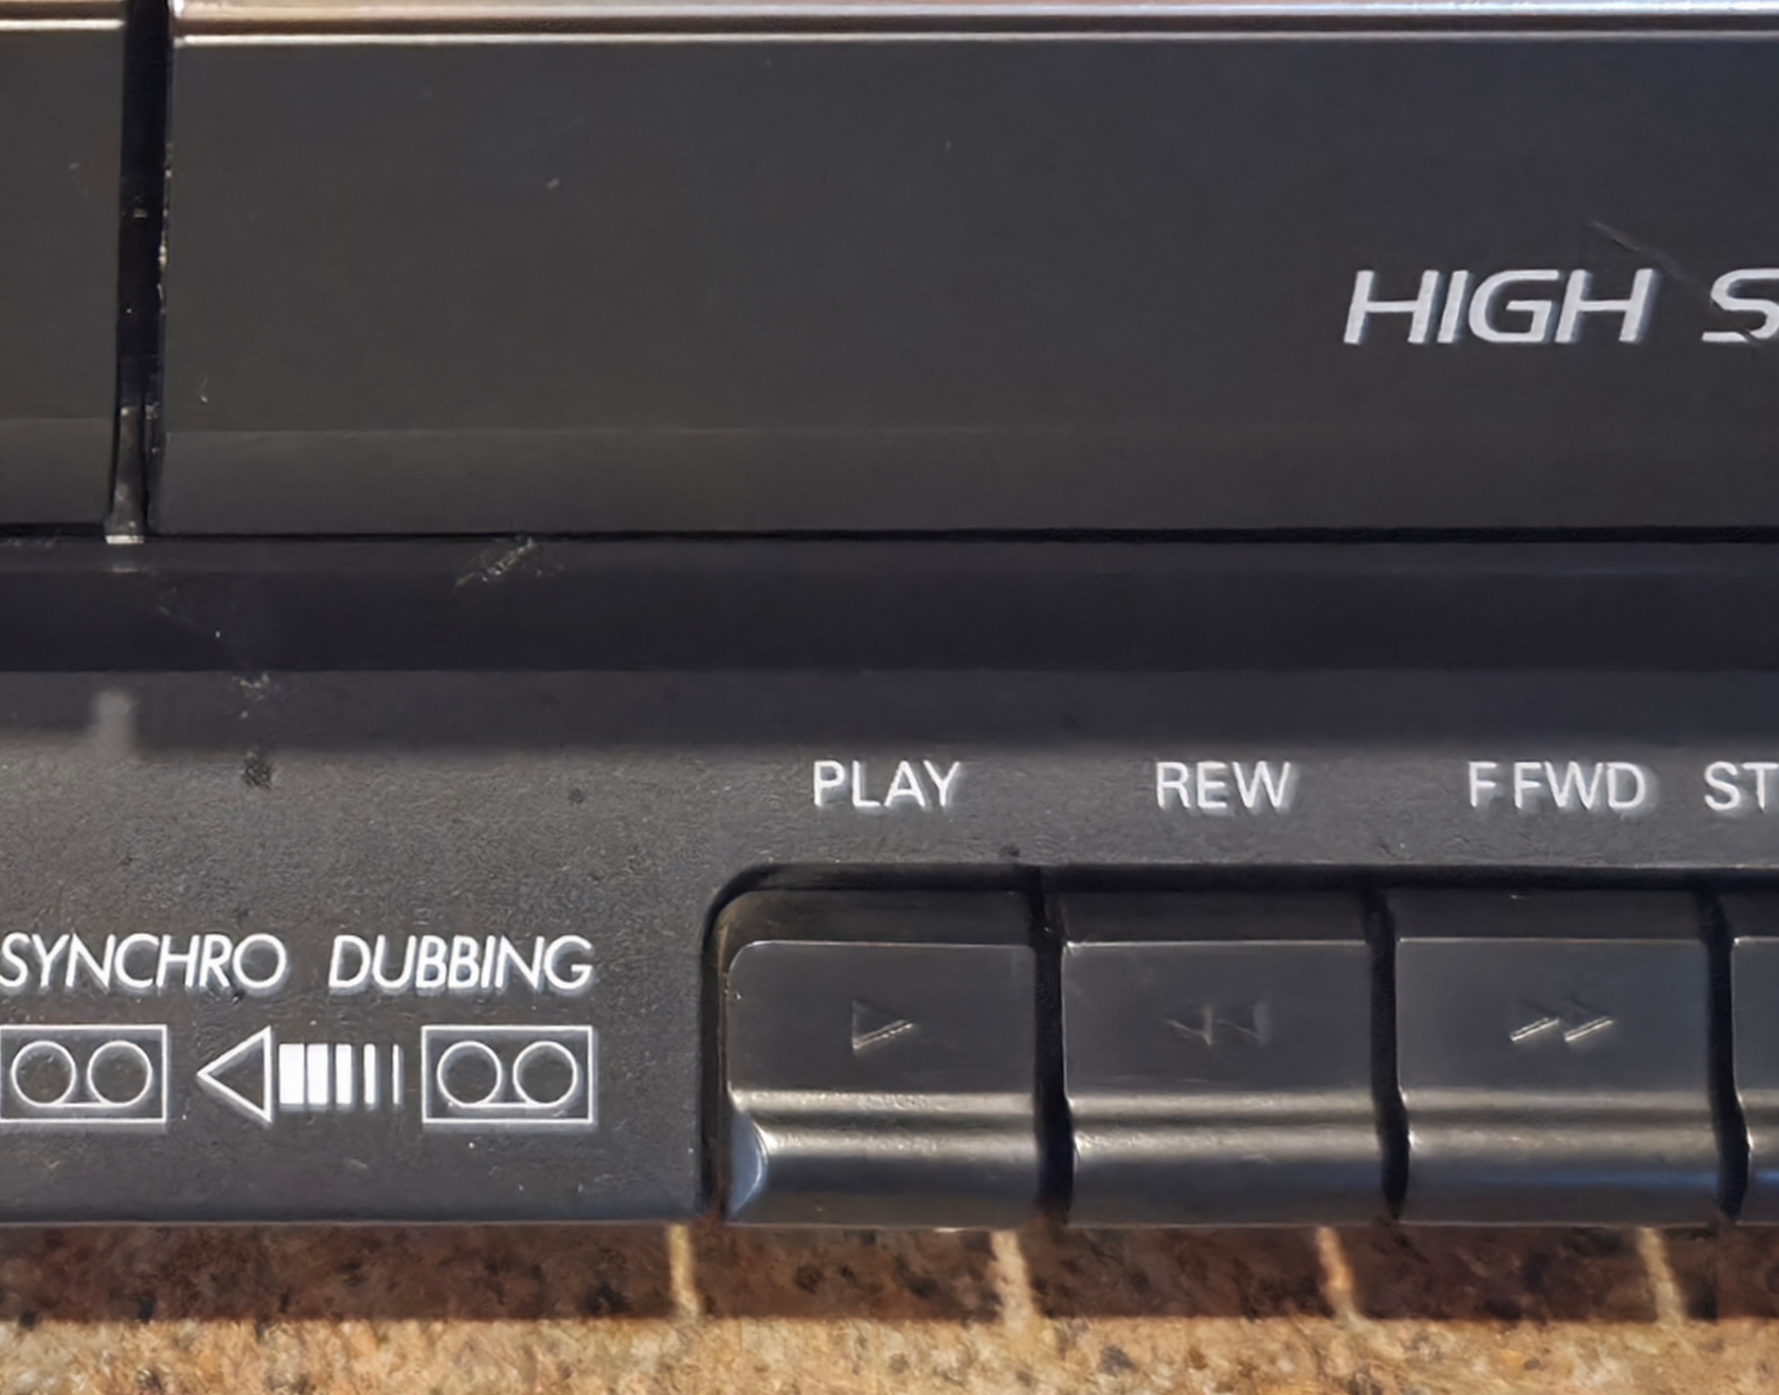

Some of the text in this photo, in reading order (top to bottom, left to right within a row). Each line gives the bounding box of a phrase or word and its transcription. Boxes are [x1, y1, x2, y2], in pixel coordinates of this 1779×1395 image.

[1343, 268, 1651, 343] HIGH
[813, 760, 961, 810] PLAY
[1156, 760, 1292, 811] REW
[328, 934, 593, 992] DUBBING
